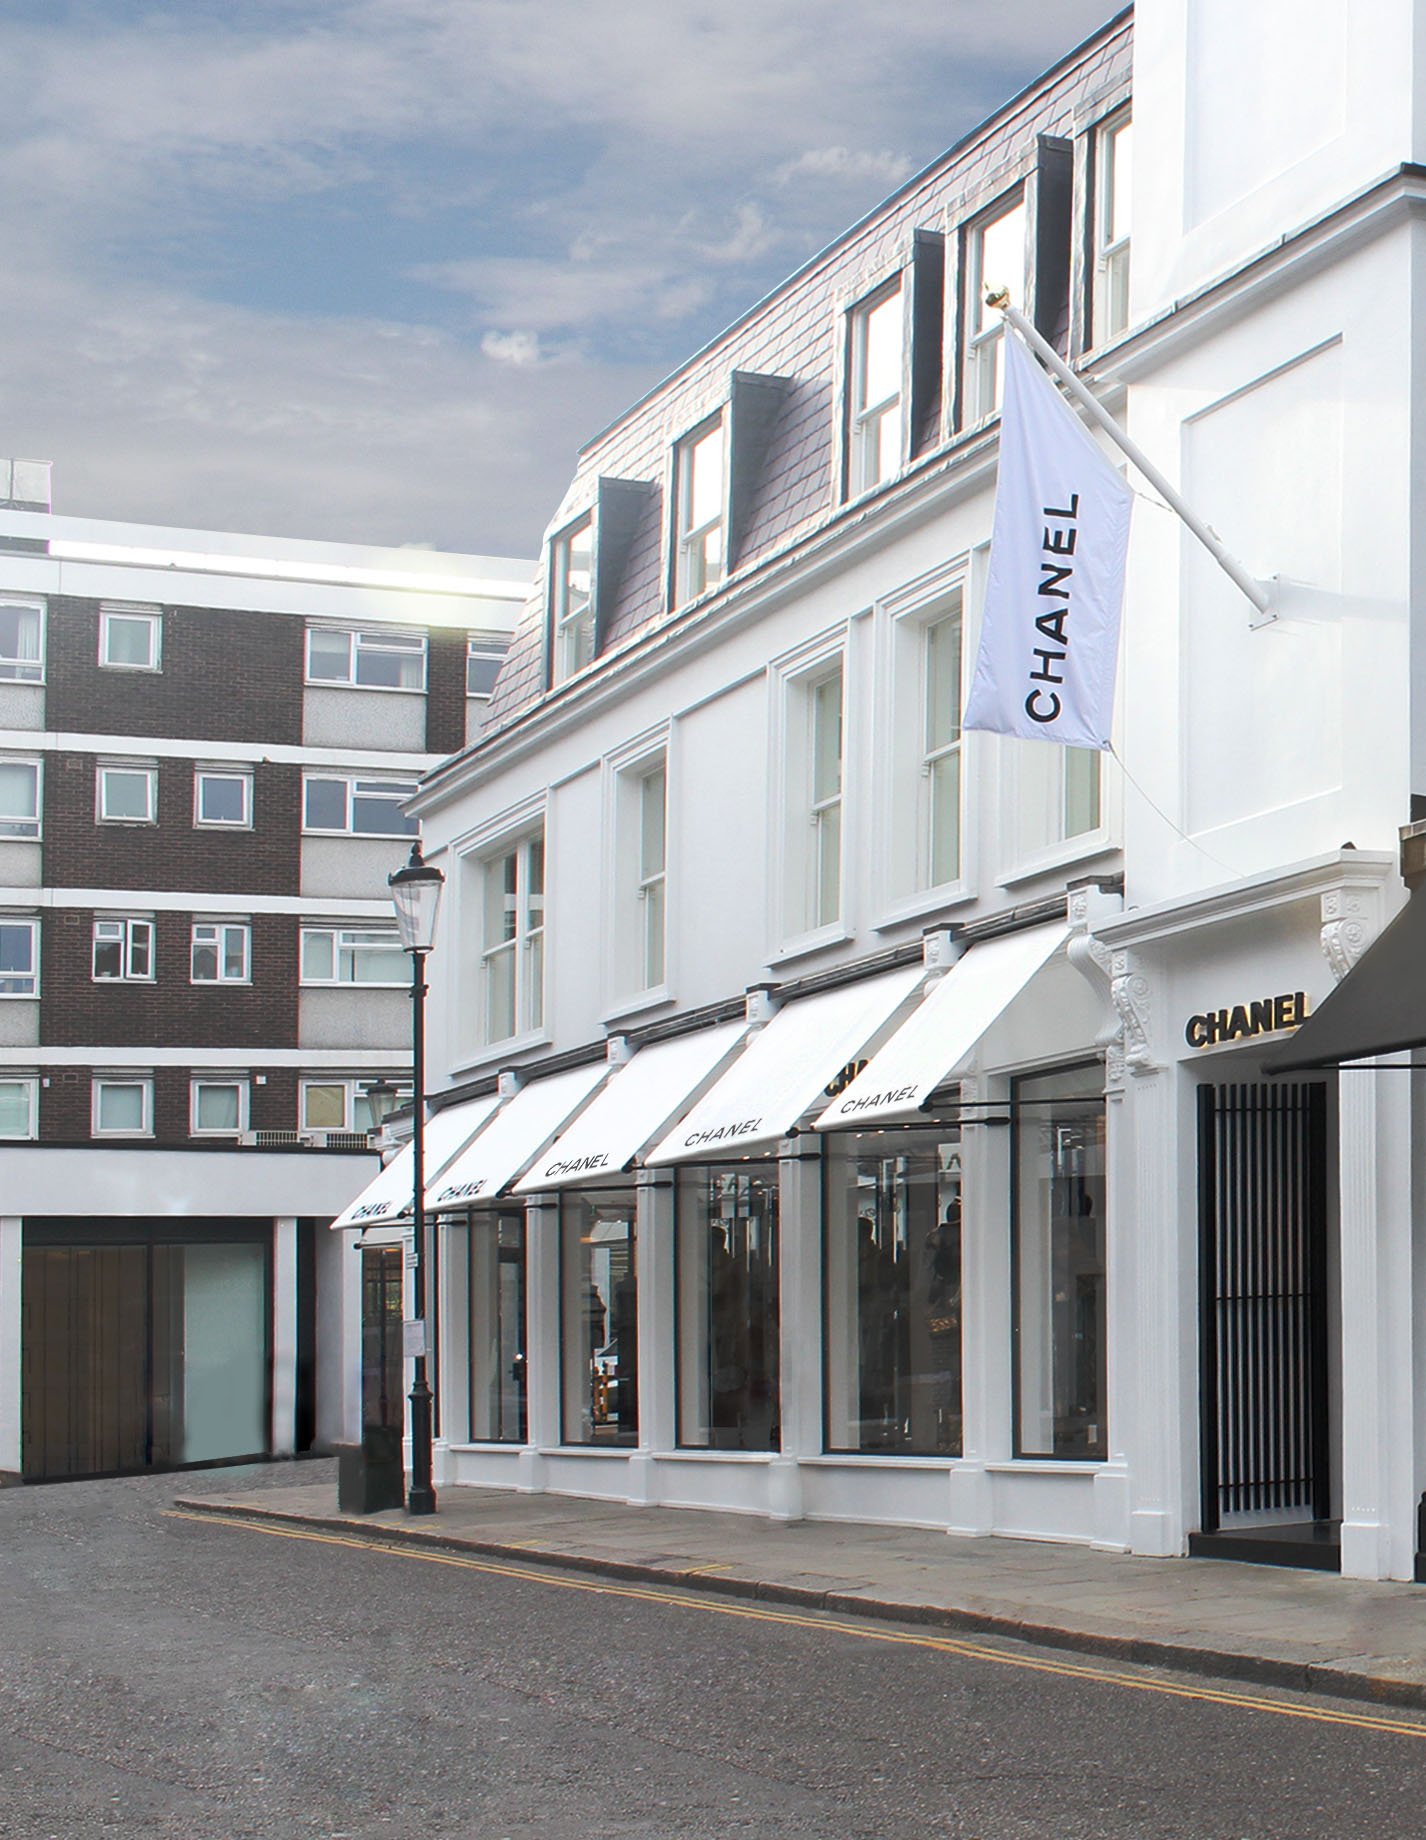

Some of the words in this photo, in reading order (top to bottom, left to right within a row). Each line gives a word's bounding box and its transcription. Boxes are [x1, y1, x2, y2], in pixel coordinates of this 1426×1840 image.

[1024, 492, 1079, 723] CHANEL
[1185, 991, 1312, 1048] CHANEL
[840, 1085, 918, 1114] CHANEL
[684, 1118, 763, 1147] CHANEL
[545, 1153, 609, 1177] CHANEL
[437, 1178, 488, 1202] CHANEL
[351, 1200, 392, 1220] CHANEL
